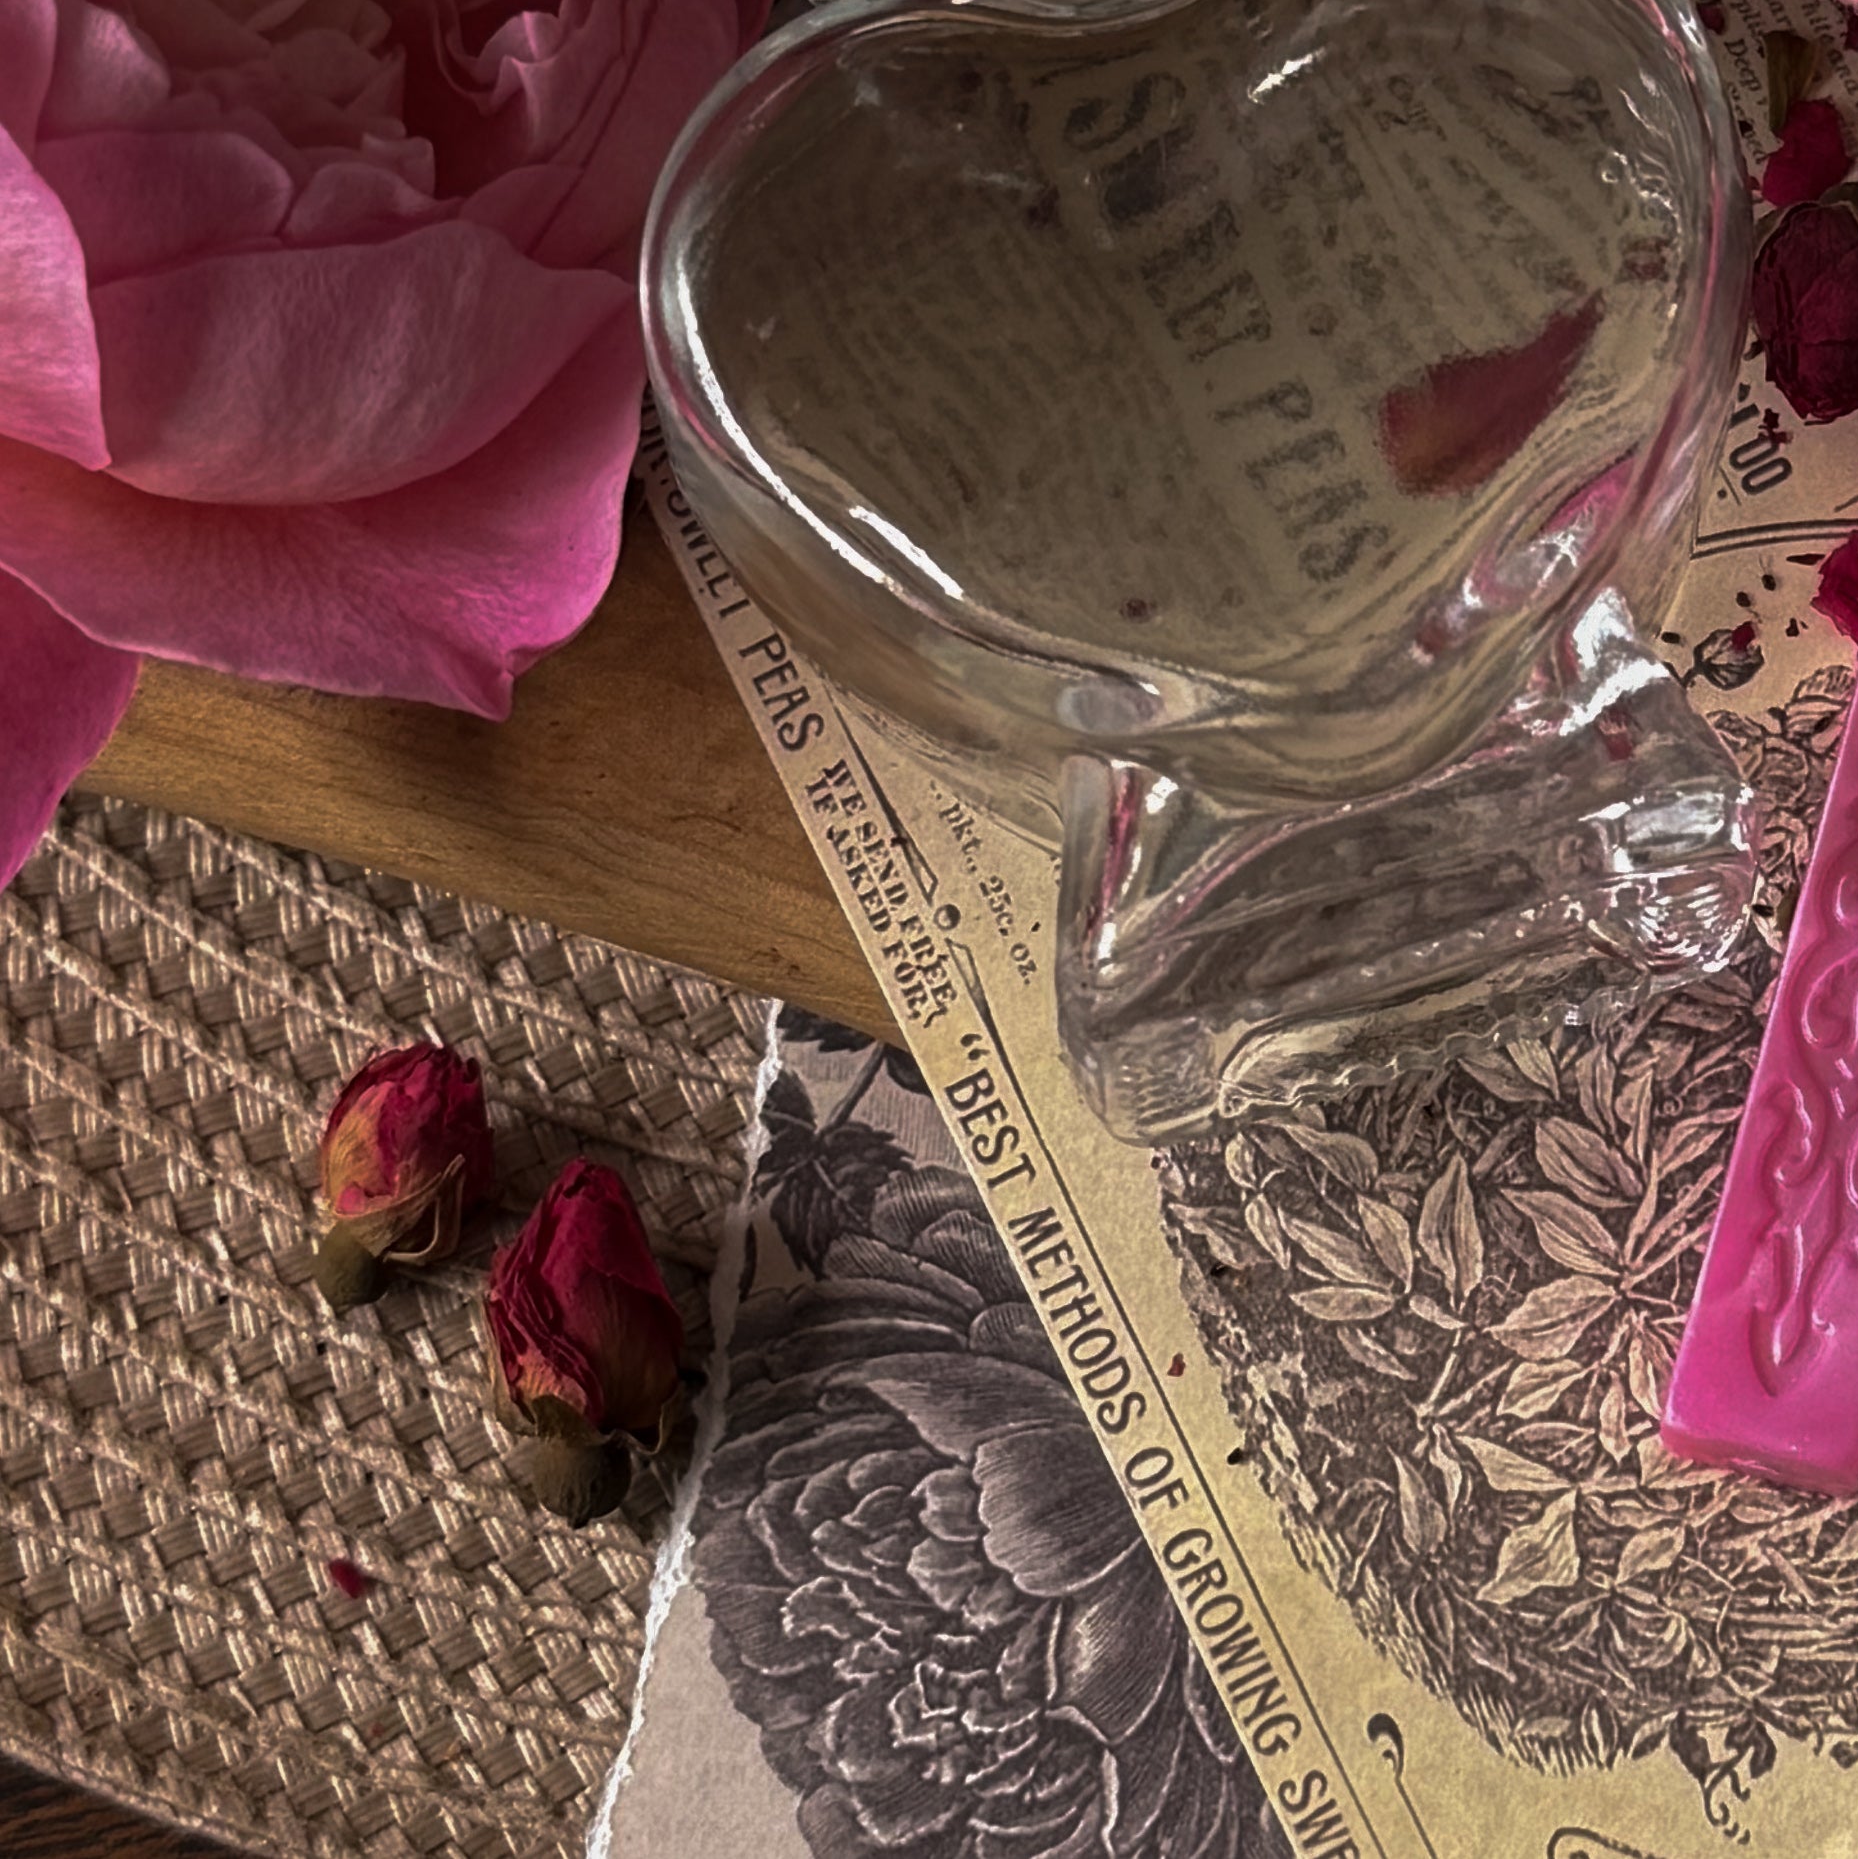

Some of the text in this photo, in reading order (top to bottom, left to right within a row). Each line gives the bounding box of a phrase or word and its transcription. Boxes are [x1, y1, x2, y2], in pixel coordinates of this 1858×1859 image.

[1723, 38, 1762, 92] Deep
[737, 632, 825, 752] PEAS
[821, 758, 868, 819] WE
[804, 777, 838, 815] IF
[826, 828, 902, 933] ASKED
[1010, 942, 1037, 988] oz.
[1006, 1206, 1147, 1433] METHODS
[1124, 1447, 1190, 1525] OF
[1162, 1528, 1302, 1764] GROWING
